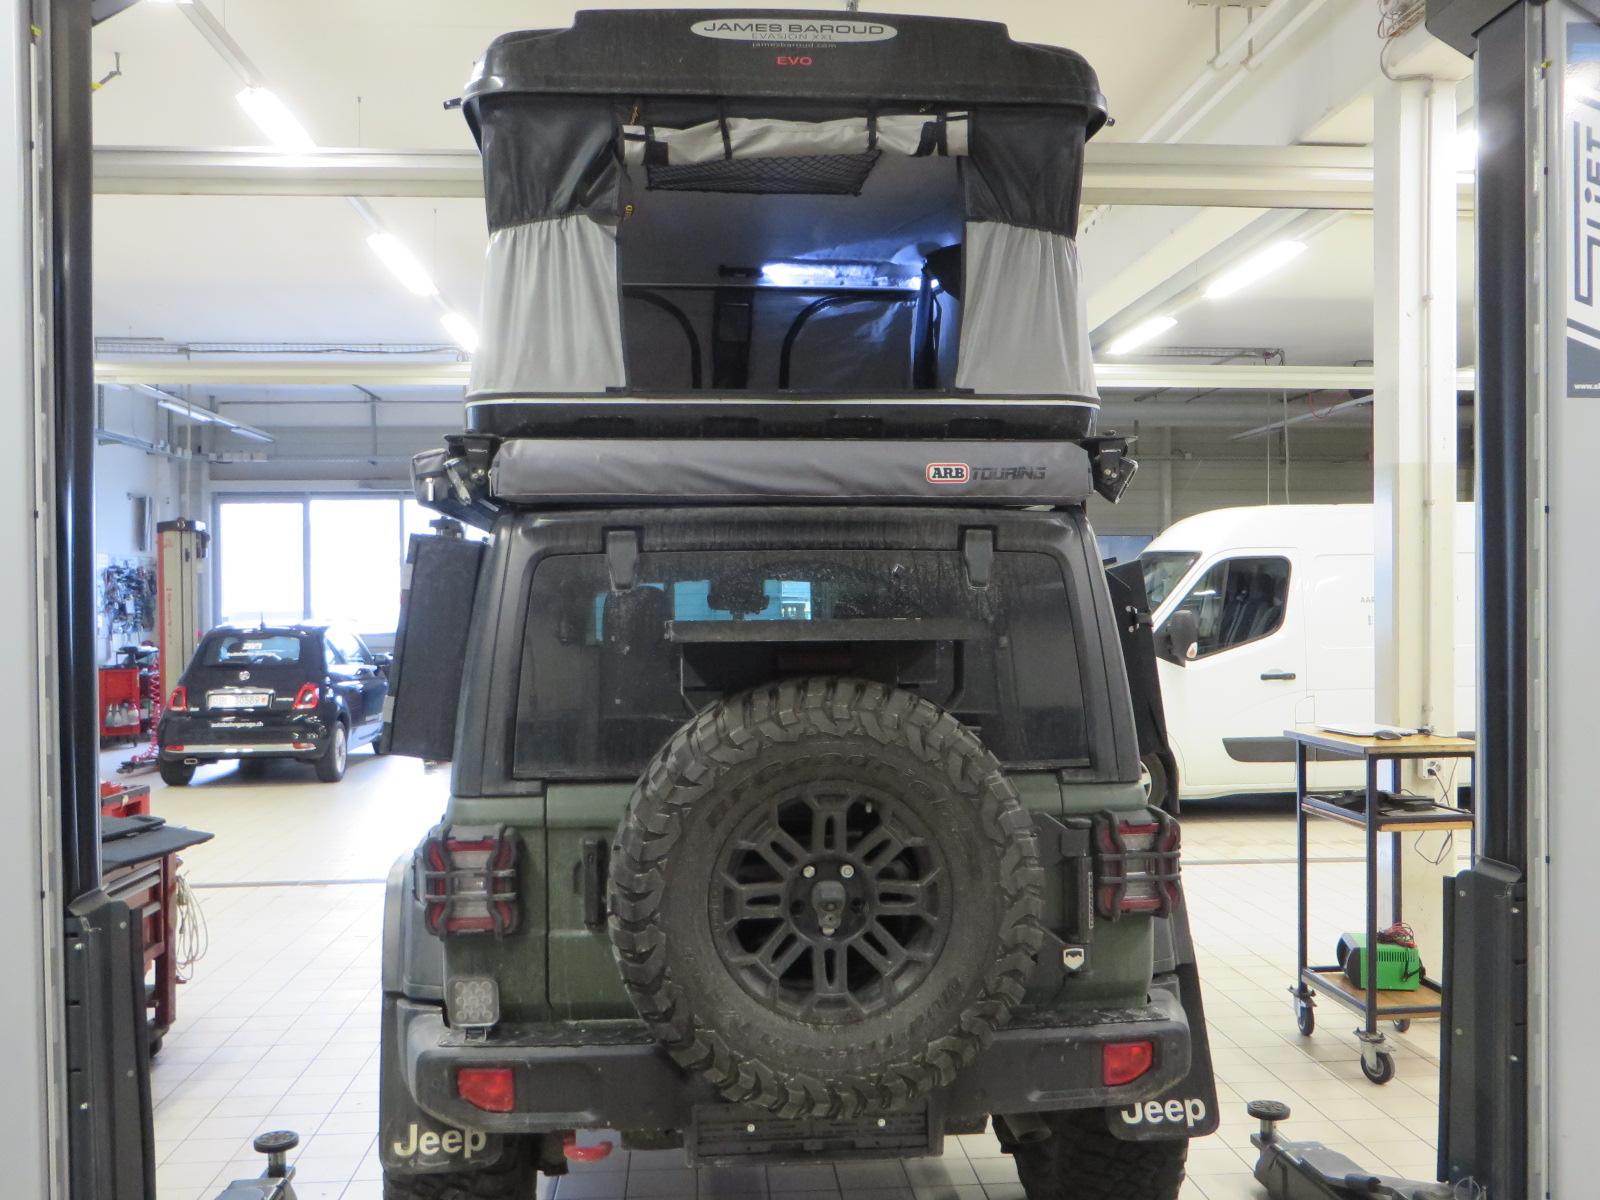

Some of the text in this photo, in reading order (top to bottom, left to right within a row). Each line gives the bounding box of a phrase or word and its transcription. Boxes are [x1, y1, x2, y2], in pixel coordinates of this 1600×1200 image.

[703, 22, 885, 35] JAMES BAROUD
[776, 56, 813, 65] EVO
[931, 466, 1048, 481] ARB TOURING
[1121, 1098, 1206, 1128] Jeep
[393, 1123, 487, 1159] Jeep
